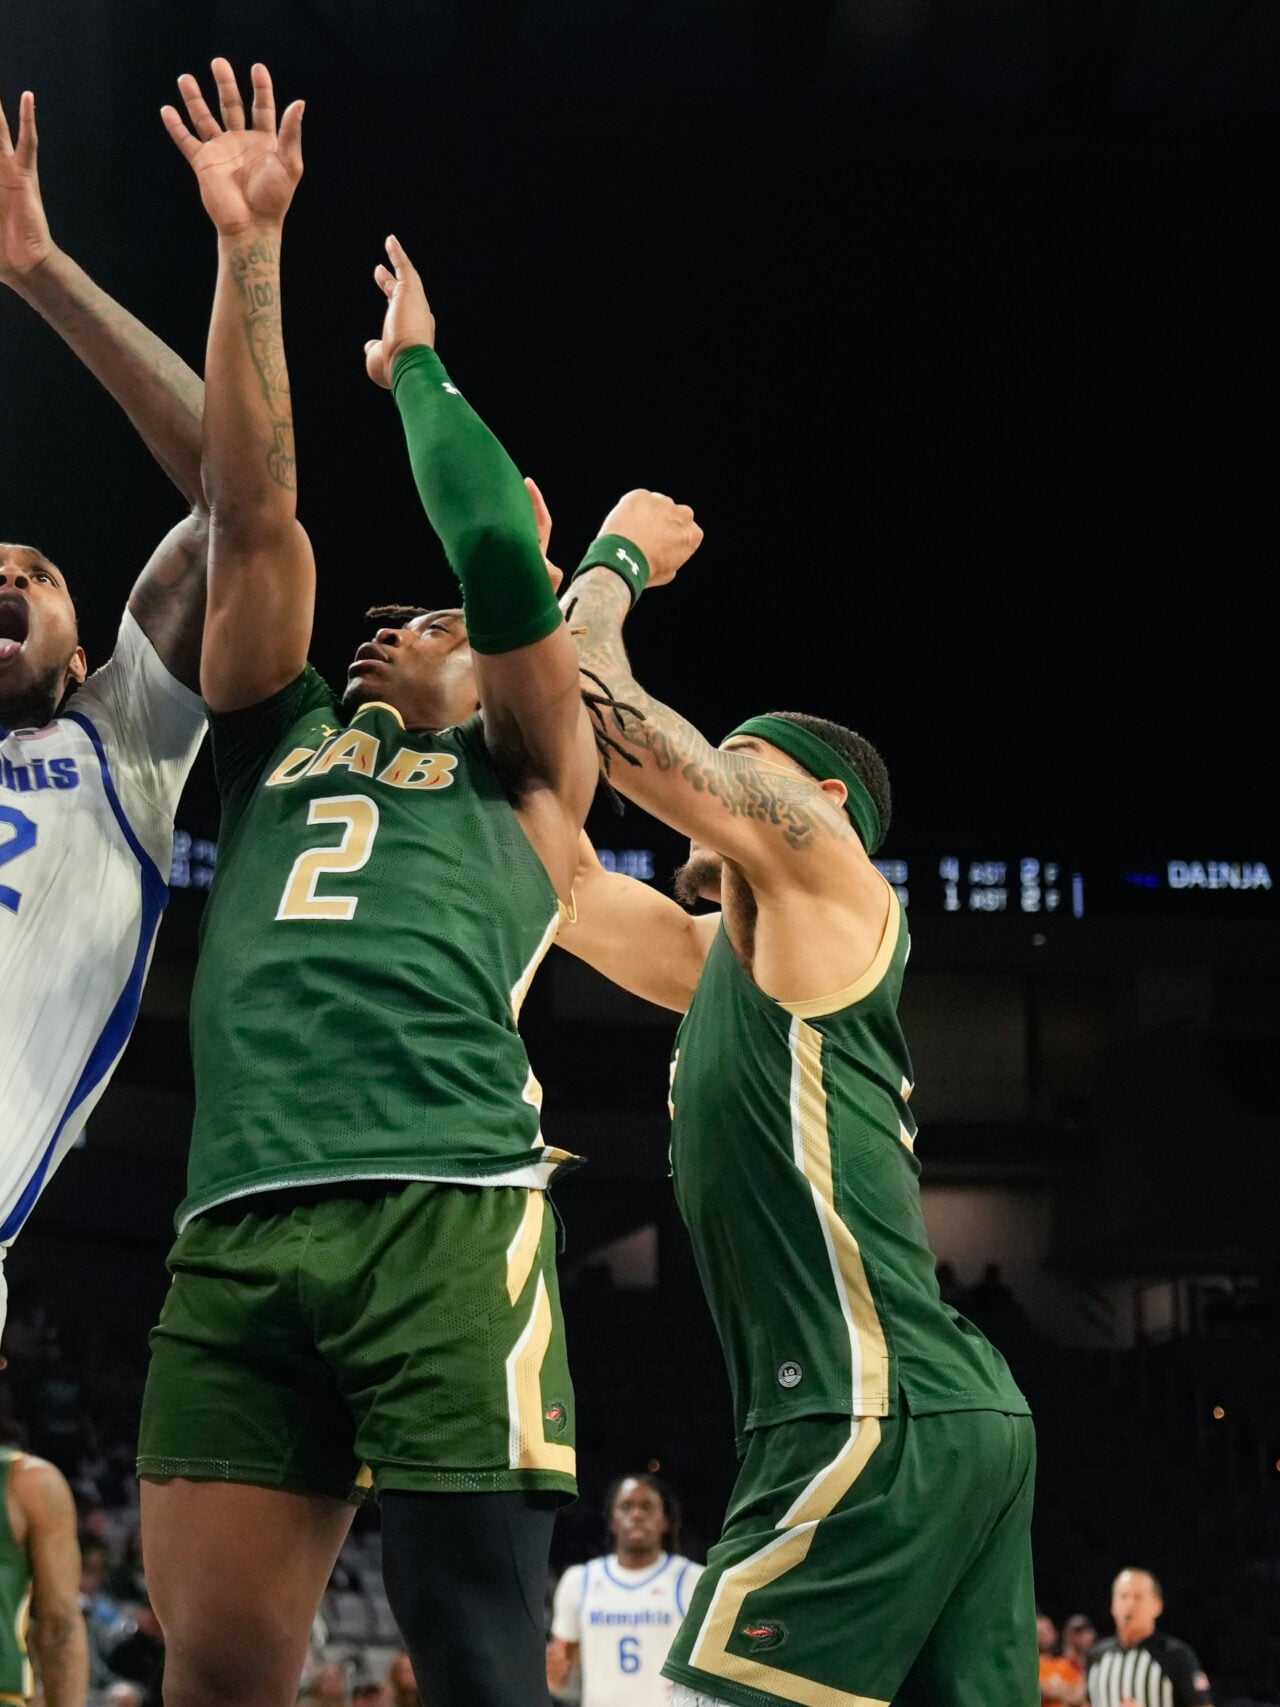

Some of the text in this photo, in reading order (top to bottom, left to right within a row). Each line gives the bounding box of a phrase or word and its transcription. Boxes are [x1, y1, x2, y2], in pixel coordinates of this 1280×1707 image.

[265, 728, 458, 789] UAB
[275, 794, 379, 920] 2
[619, 1637, 641, 1674] 6
